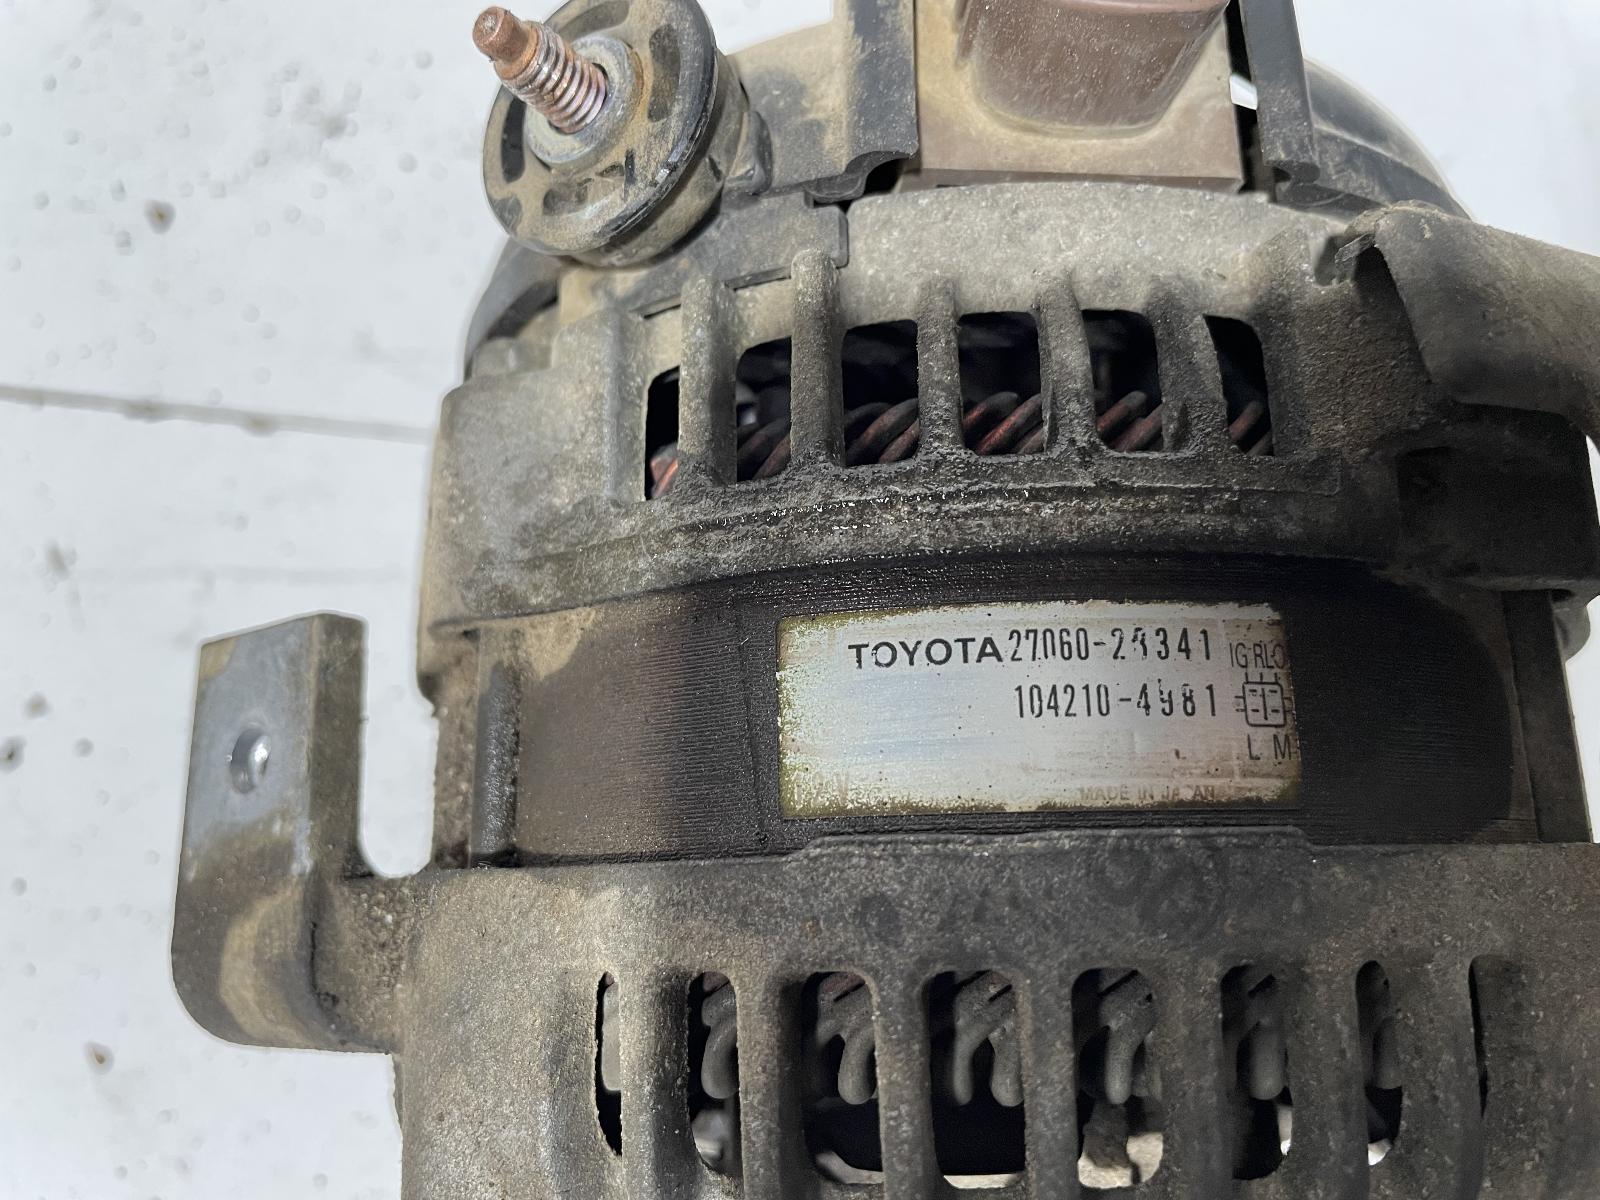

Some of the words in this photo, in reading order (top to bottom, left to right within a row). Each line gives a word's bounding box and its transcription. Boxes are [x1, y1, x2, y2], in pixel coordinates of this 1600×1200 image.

[848, 636, 1003, 669] TOYOTA
[1014, 679, 1217, 718] 104210-4981
[1161, 784, 1216, 802] JAAN
